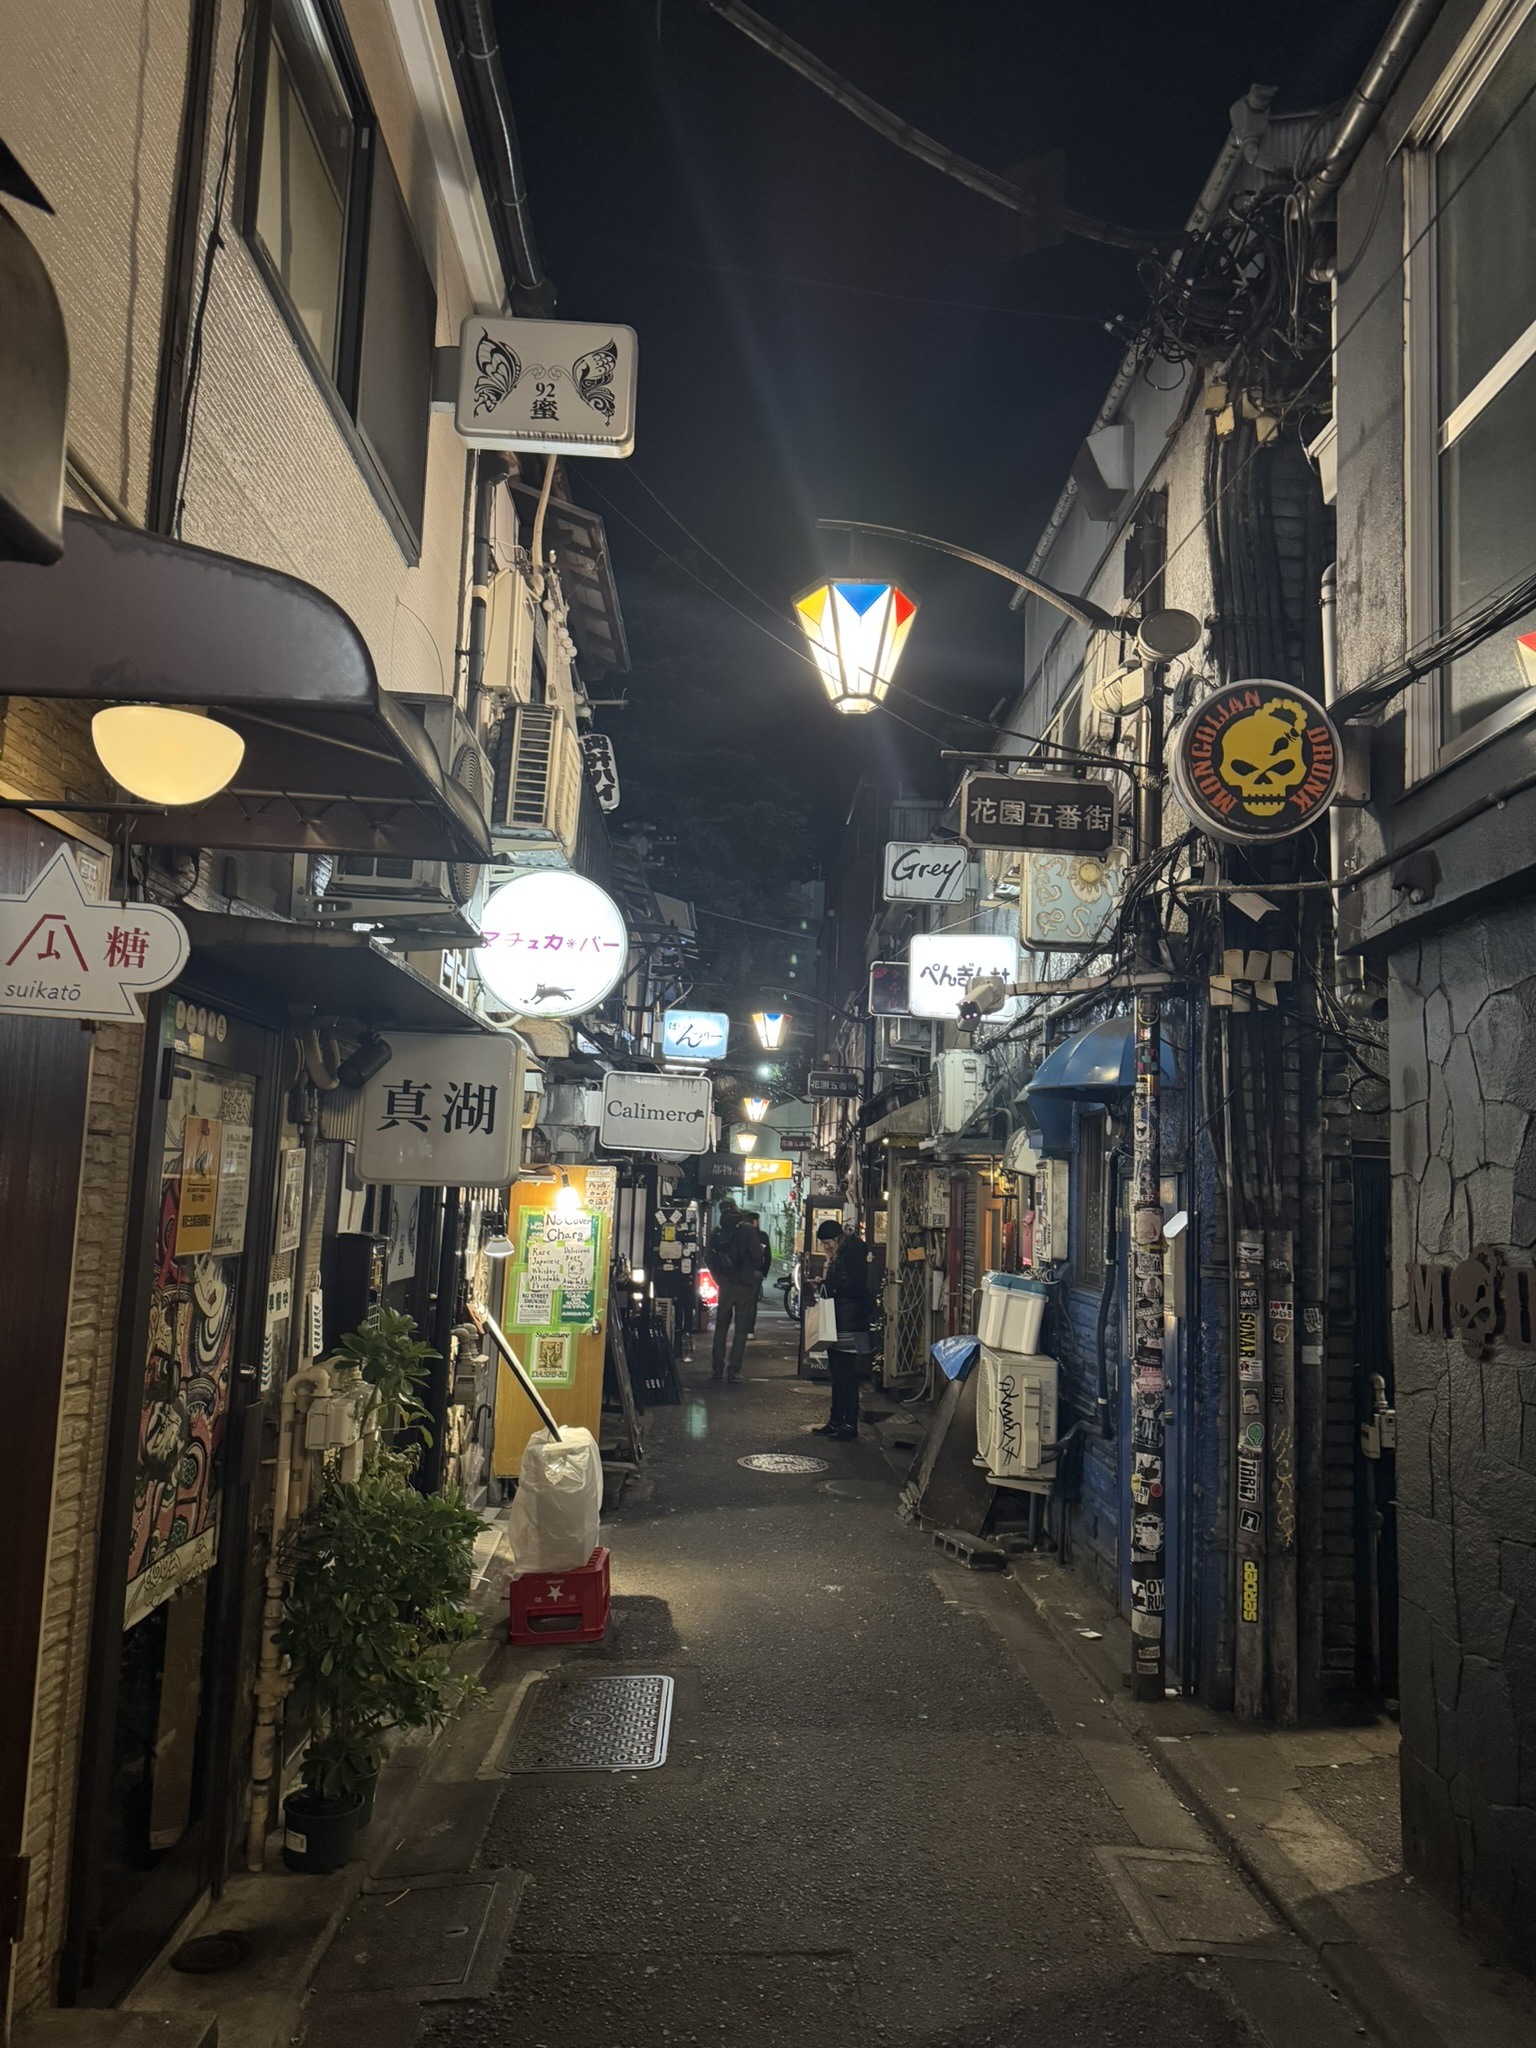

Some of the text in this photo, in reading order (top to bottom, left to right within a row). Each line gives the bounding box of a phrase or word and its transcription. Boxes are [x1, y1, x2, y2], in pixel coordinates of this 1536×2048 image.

[535, 382, 556, 398] 92
[530, 398, 560, 421] 蜜
[1190, 690, 1262, 815] MONGOLIAN
[1288, 725, 1334, 814] DRUNK
[970, 797, 1112, 831] 花園五番街
[890, 848, 962, 899] Grey
[4, 980, 82, 1001] suikatō
[376, 1079, 499, 1135] 真湖
[606, 1099, 698, 1125] Calimero
[546, 1213, 591, 1226] No Cover
[531, 1256, 561, 1266] Japanese
[1239, 1313, 1256, 1360] SONAR
